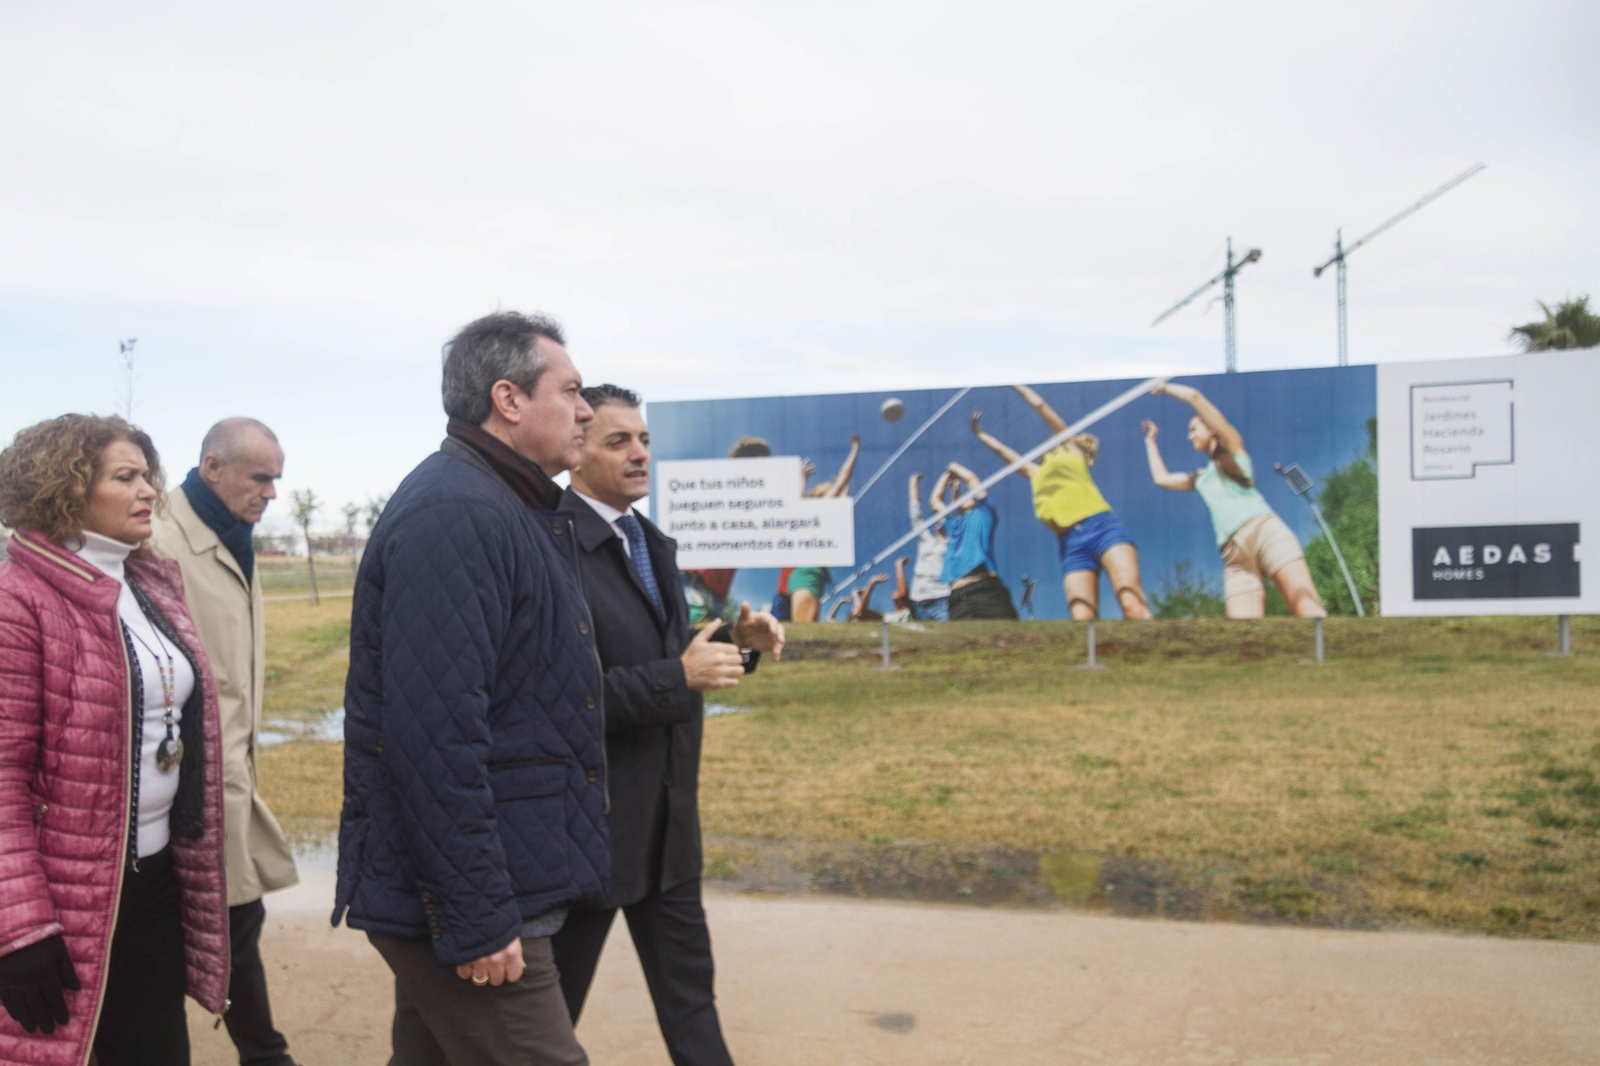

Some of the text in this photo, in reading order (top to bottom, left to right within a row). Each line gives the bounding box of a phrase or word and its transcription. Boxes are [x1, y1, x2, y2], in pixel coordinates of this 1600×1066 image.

[669, 477, 765, 492] Que tus niños
[728, 499, 784, 512] seguros
[669, 516, 821, 533] junto a casa, alargará
[677, 536, 838, 552] us momentos de relax.
[1432, 543, 1552, 566] AEDAS
[1432, 567, 1485, 581] HOMES
